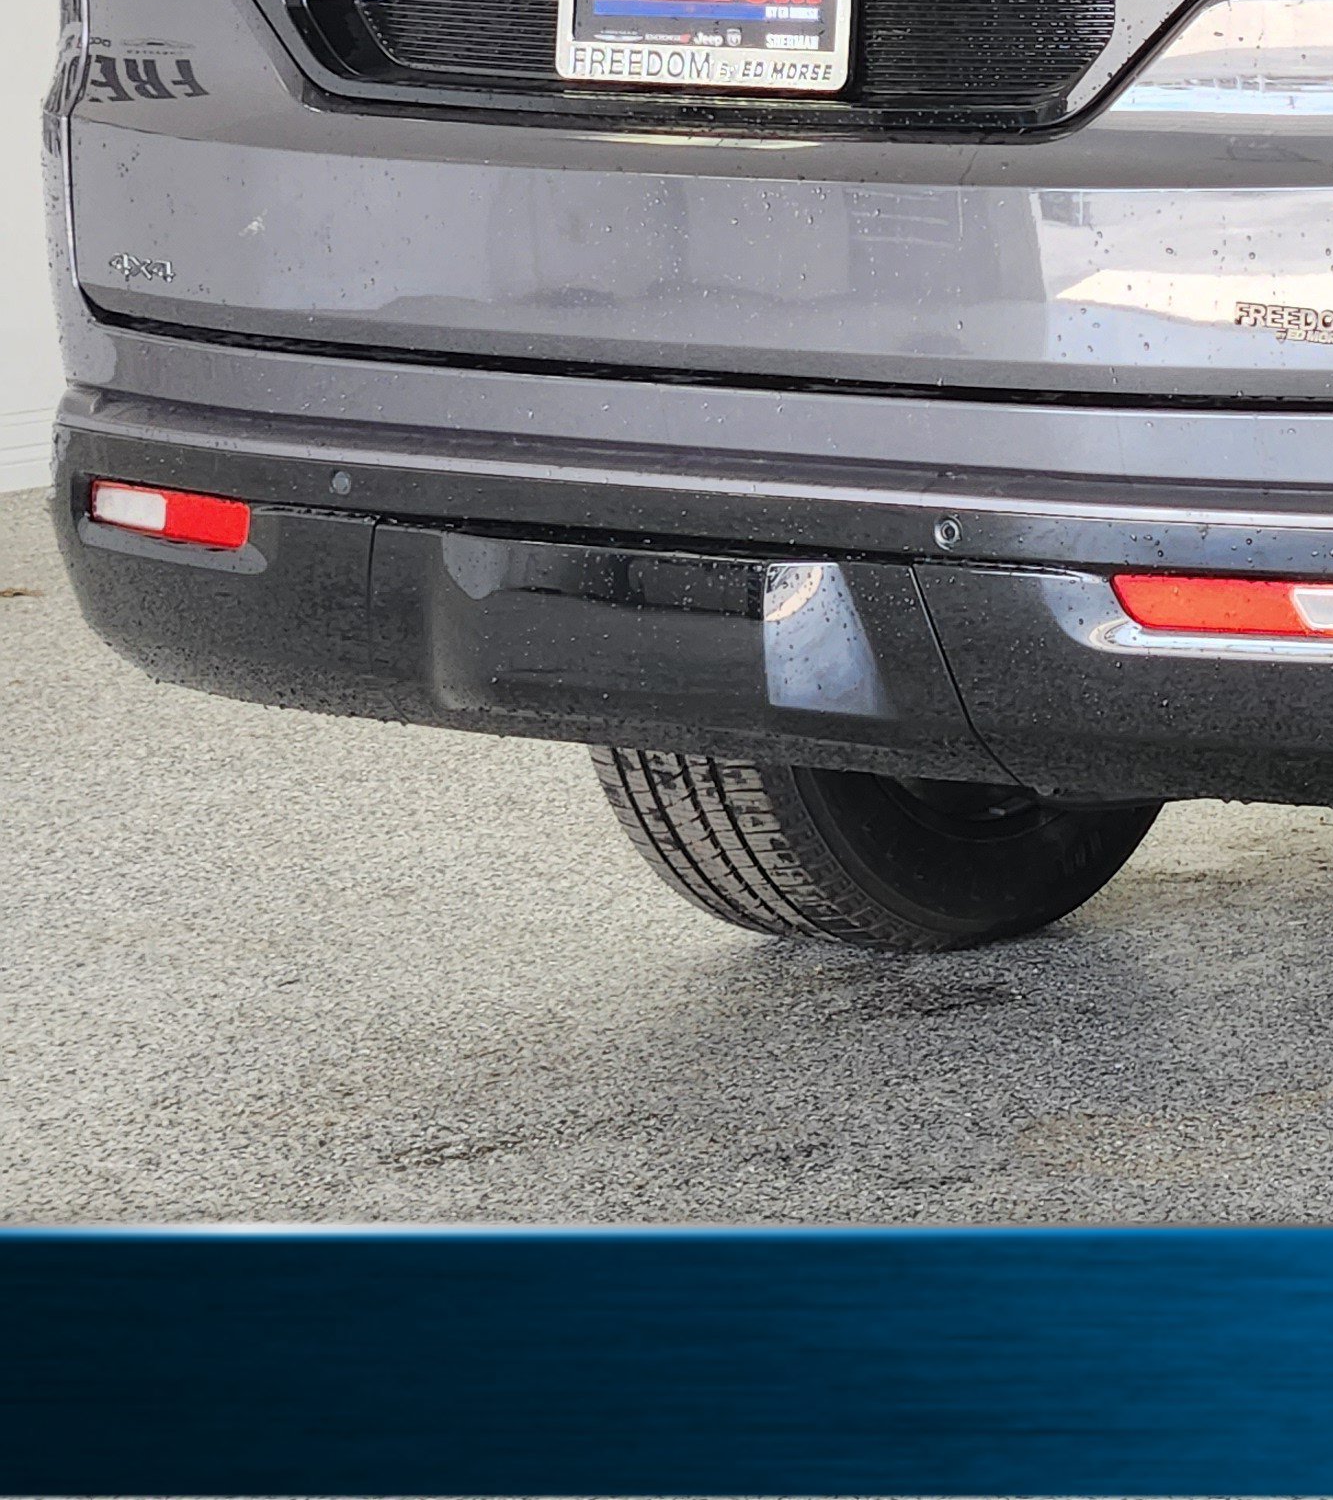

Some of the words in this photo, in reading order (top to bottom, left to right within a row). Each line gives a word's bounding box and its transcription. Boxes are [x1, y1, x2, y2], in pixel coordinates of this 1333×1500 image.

[692, 30, 723, 47] Jeep
[765, 33, 819, 50] SHERMAN
[573, 48, 711, 79] FREEDOM
[741, 61, 764, 78] ED
[770, 61, 833, 81] MORSE
